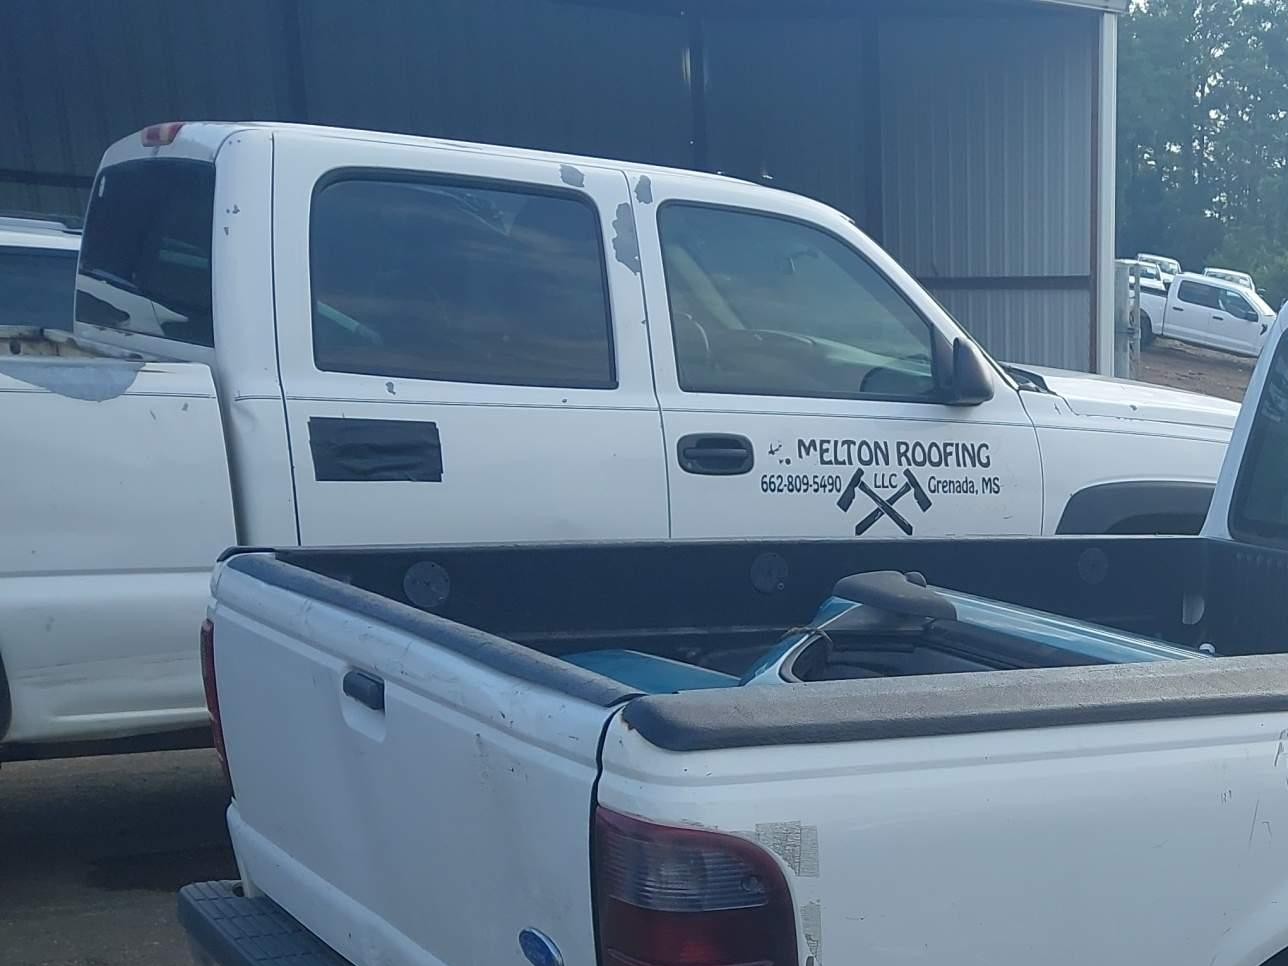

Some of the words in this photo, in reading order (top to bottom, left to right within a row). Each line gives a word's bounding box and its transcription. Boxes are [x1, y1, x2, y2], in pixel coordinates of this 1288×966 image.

[797, 439, 890, 466] MELTON
[897, 441, 991, 469] ROOFING
[760, 475, 842, 494] 662-809-5490
[873, 474, 898, 489] LLC
[927, 476, 979, 496] Grenada,
[981, 477, 1001, 495] MS
